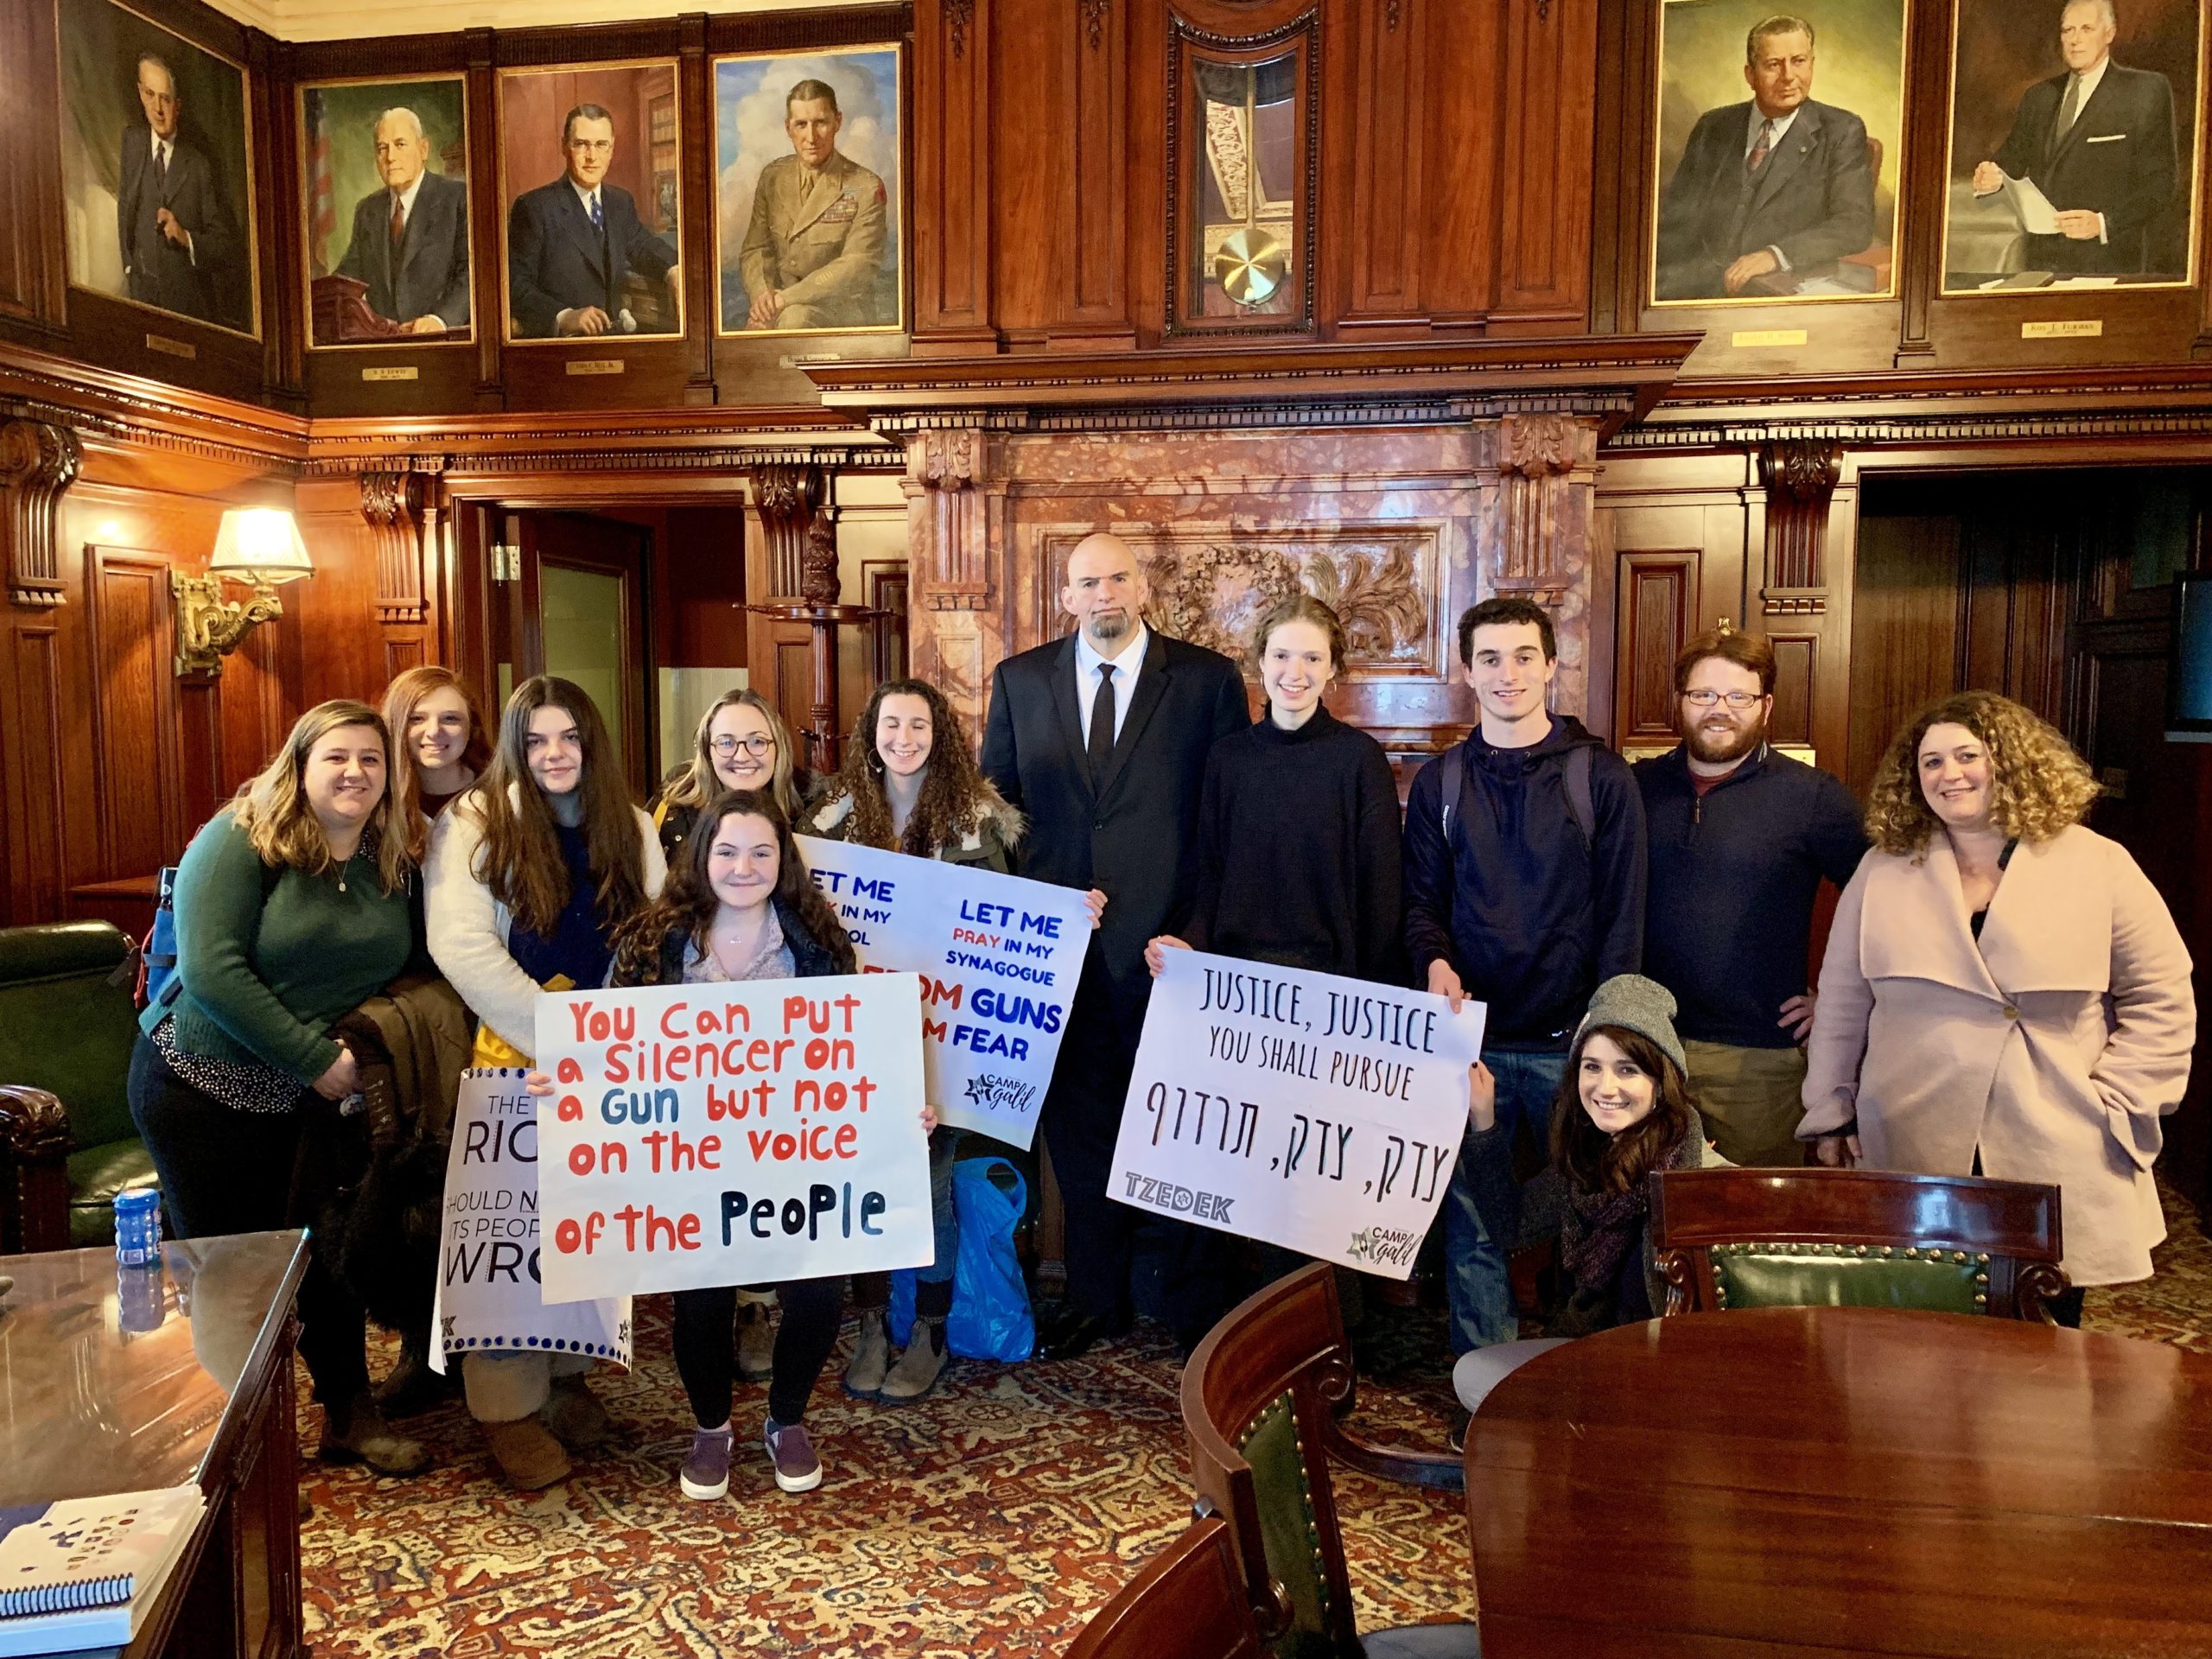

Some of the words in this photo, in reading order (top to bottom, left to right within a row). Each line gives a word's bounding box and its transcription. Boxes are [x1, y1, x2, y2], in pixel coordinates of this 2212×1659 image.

[810, 868, 848, 893] ET
[853, 876, 895, 903] ME
[841, 904, 859, 918] IN
[863, 908, 891, 924] MY
[960, 899, 1014, 927] LET
[1020, 911, 1063, 939] ME
[953, 927, 1001, 949] PRAY
[1004, 938, 1021, 952] IN
[1026, 943, 1054, 960] MY
[945, 950, 1056, 987] SYNAGOGUE
[970, 988, 1064, 1034] GUNS
[1199, 968, 1313, 1033] JUSTICE,
[1323, 991, 1437, 1053] JUSTICE
[557, 1057, 583, 1084] a
[804, 1038, 855, 1071] on
[953, 1025, 1029, 1061] FEAR
[987, 1074, 1020, 1090] CAMP
[1209, 1025, 1251, 1065] YOU
[1258, 1035, 1319, 1081] SHALL
[1331, 1051, 1414, 1102] PURSUE
[488, 1096, 531, 1115] THE
[557, 1095, 583, 1122] a
[706, 1080, 776, 1122] but
[793, 1076, 877, 1113] not
[568, 1141, 626, 1176] on
[642, 1130, 721, 1173] the
[747, 1118, 858, 1162] voice
[447, 1190, 512, 1216] HOULD
[1124, 1172, 1236, 1224] TZEDEK
[556, 1211, 605, 1255] of
[613, 1205, 702, 1252] the
[1372, 1227, 1408, 1244] CAMP
